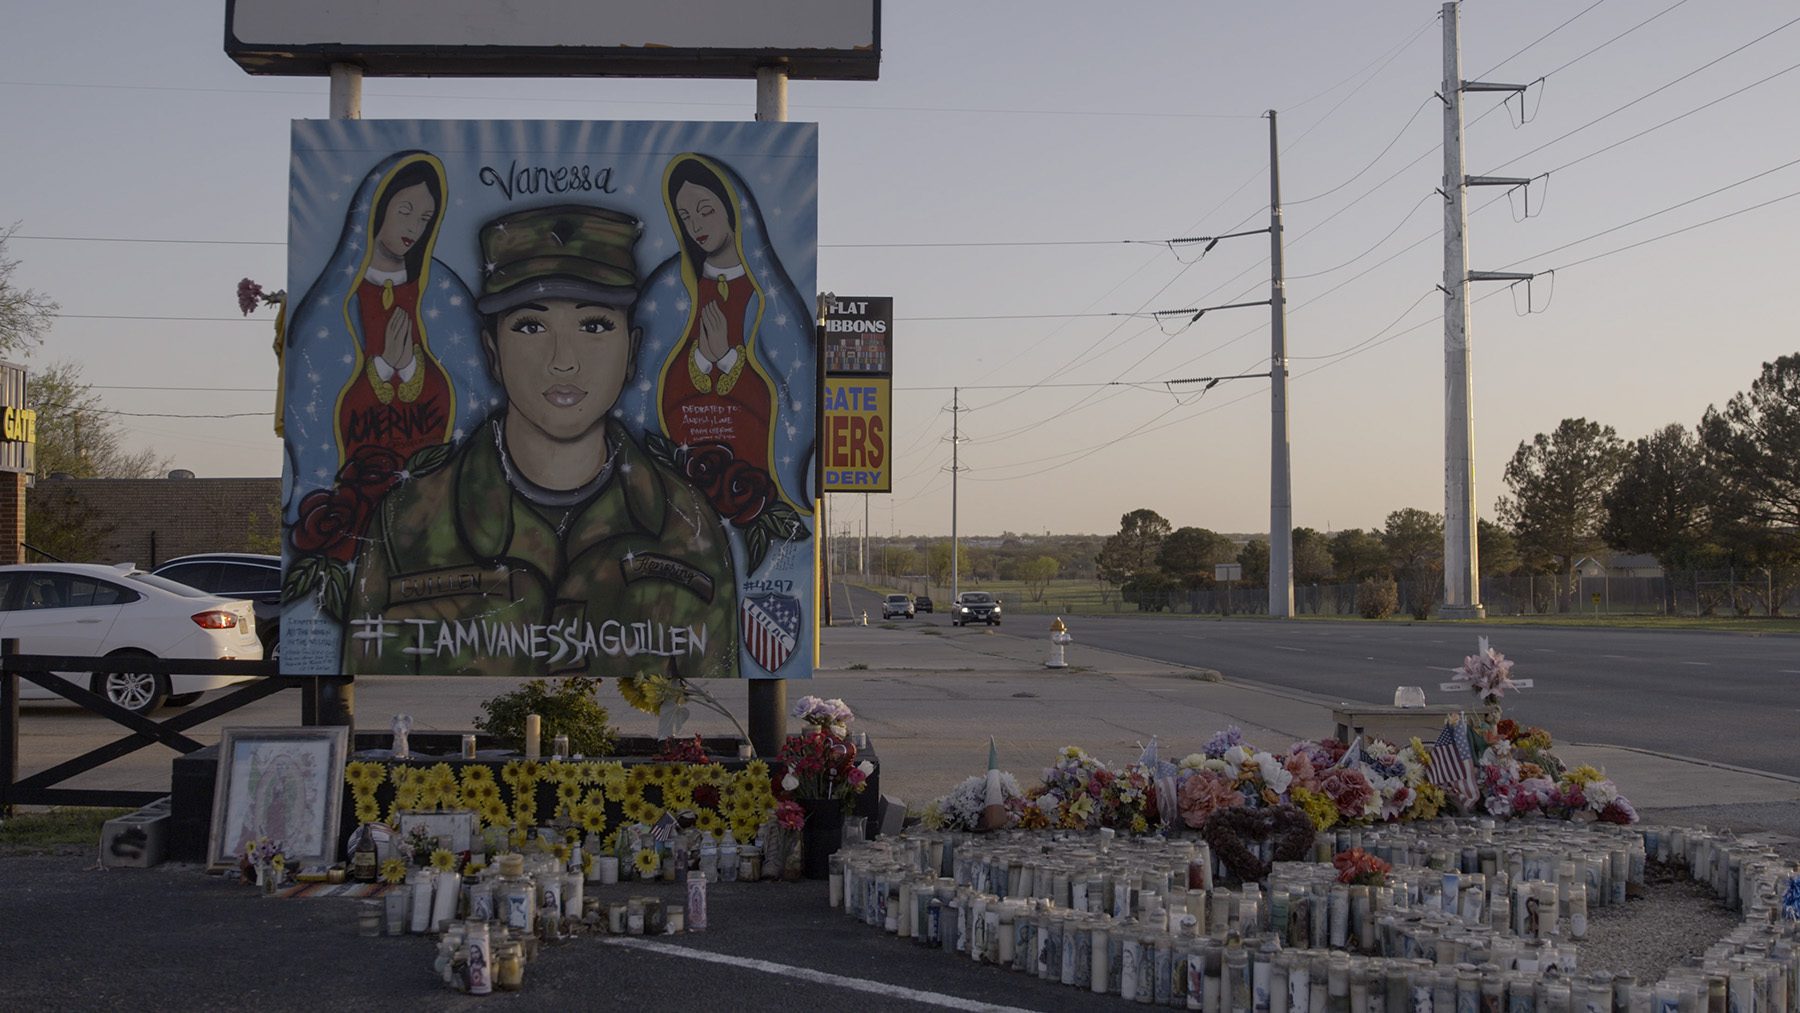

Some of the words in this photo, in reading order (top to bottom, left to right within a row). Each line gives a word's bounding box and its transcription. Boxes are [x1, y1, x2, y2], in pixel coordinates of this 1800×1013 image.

[479, 159, 618, 201] Vanessa
[829, 301, 868, 315] FLAT
[825, 319, 887, 333] IBBONS
[4, 406, 37, 444] GATE
[825, 415, 885, 469] IERS
[826, 471, 882, 485] DERY
[401, 571, 482, 598] GUILLEN
[634, 556, 699, 585] Honoring
[743, 579, 794, 593] #4297
[747, 604, 789, 644] LULAC
